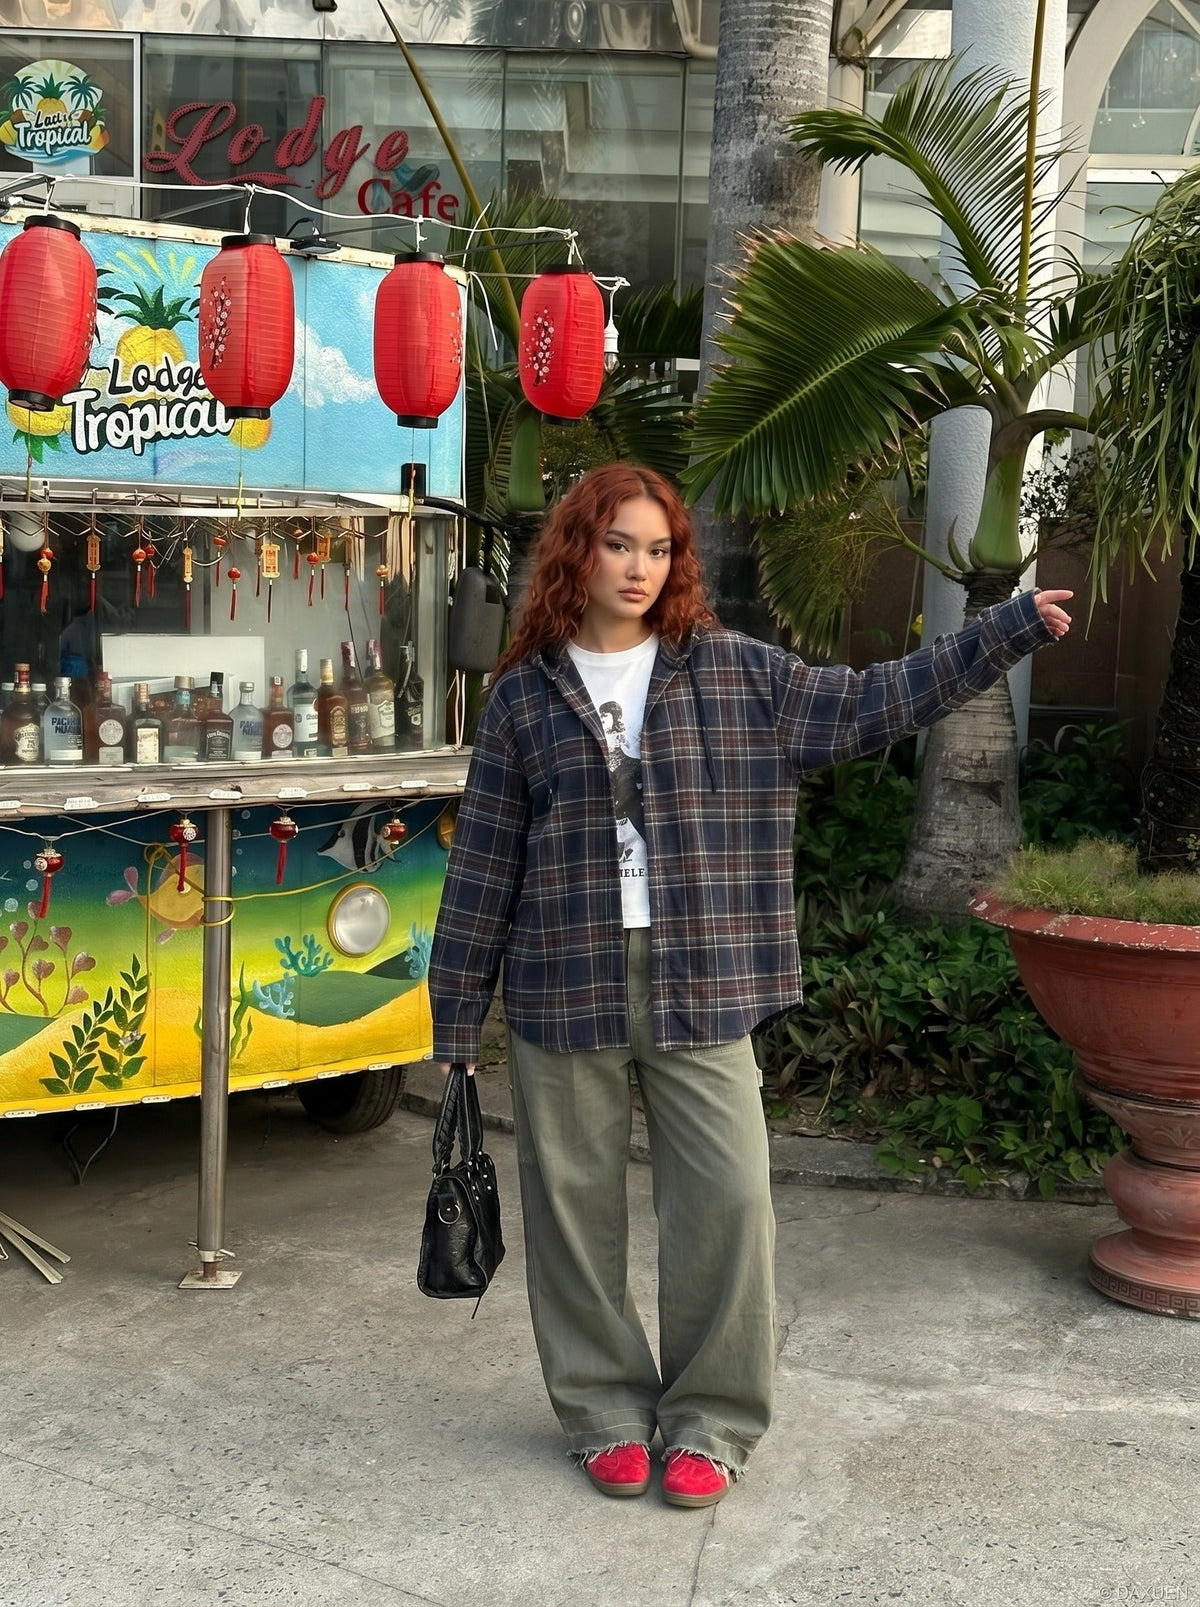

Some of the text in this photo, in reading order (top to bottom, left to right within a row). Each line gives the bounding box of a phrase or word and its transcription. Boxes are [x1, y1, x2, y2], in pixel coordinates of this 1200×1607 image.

[14, 120, 91, 155] Tropical
[143, 95, 410, 200] Lodge
[357, 177, 459, 222] Cafe
[108, 355, 206, 396] Lodge
[61, 389, 236, 456] Tropical
